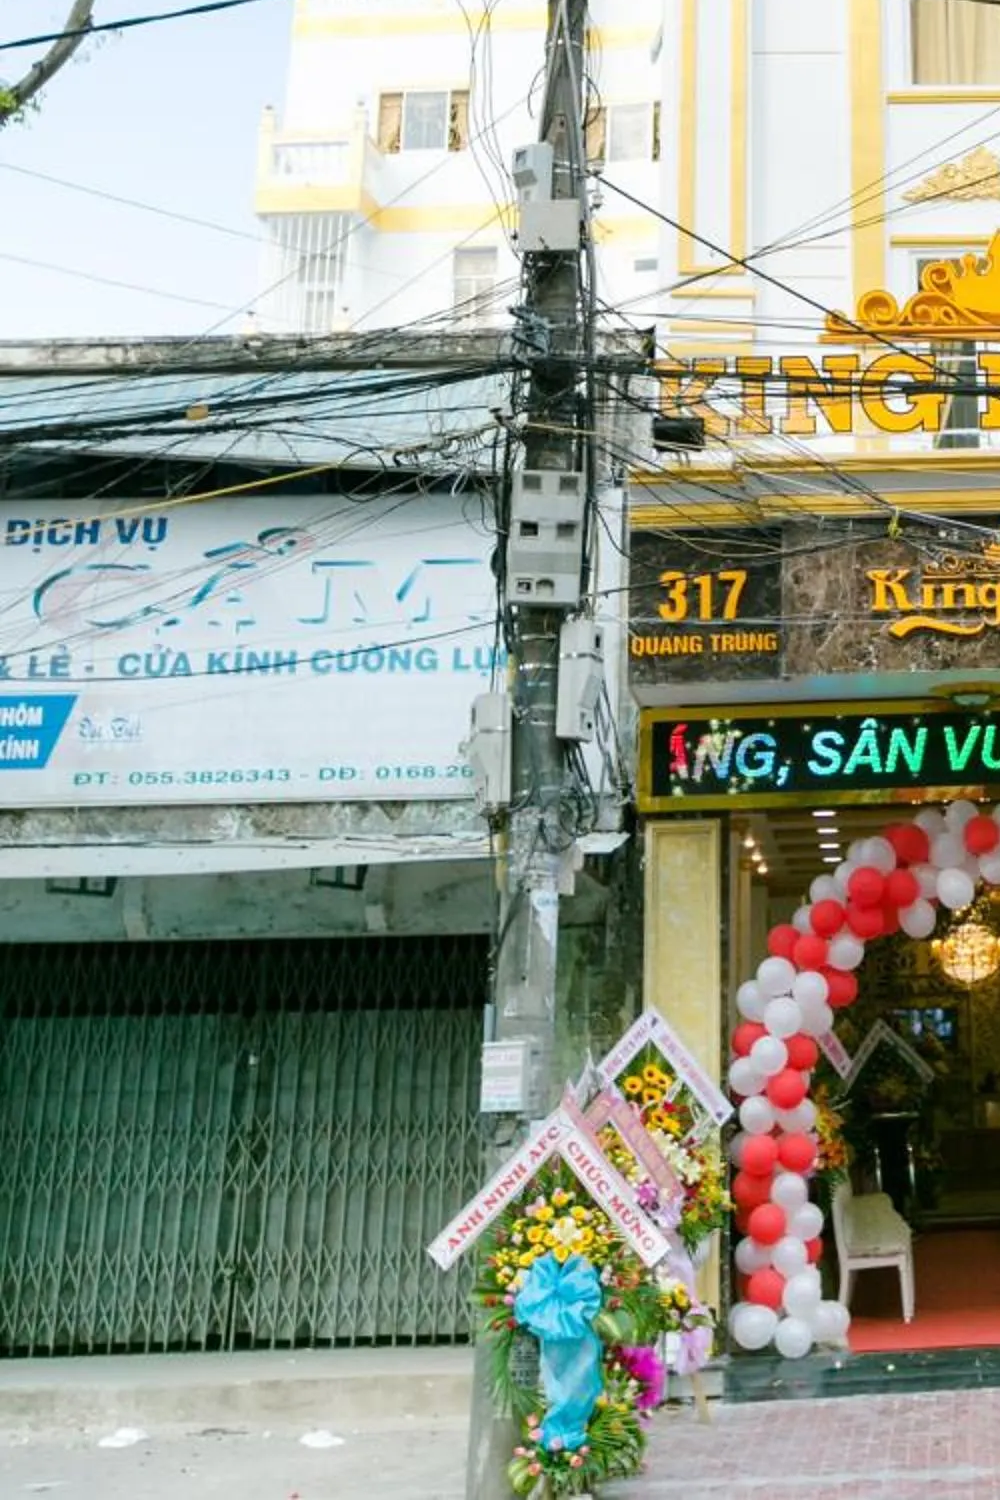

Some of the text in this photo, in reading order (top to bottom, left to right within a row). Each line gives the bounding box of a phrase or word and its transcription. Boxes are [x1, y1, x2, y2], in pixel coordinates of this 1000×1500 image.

[650, 353, 948, 435] KING
[115, 517, 168, 551] VỤ
[658, 569, 748, 621] 317
[630, 631, 778, 657] QUANG TRUNG
[807, 717, 927, 776] SÂN
[447, 1211, 485, 1250] ANH
